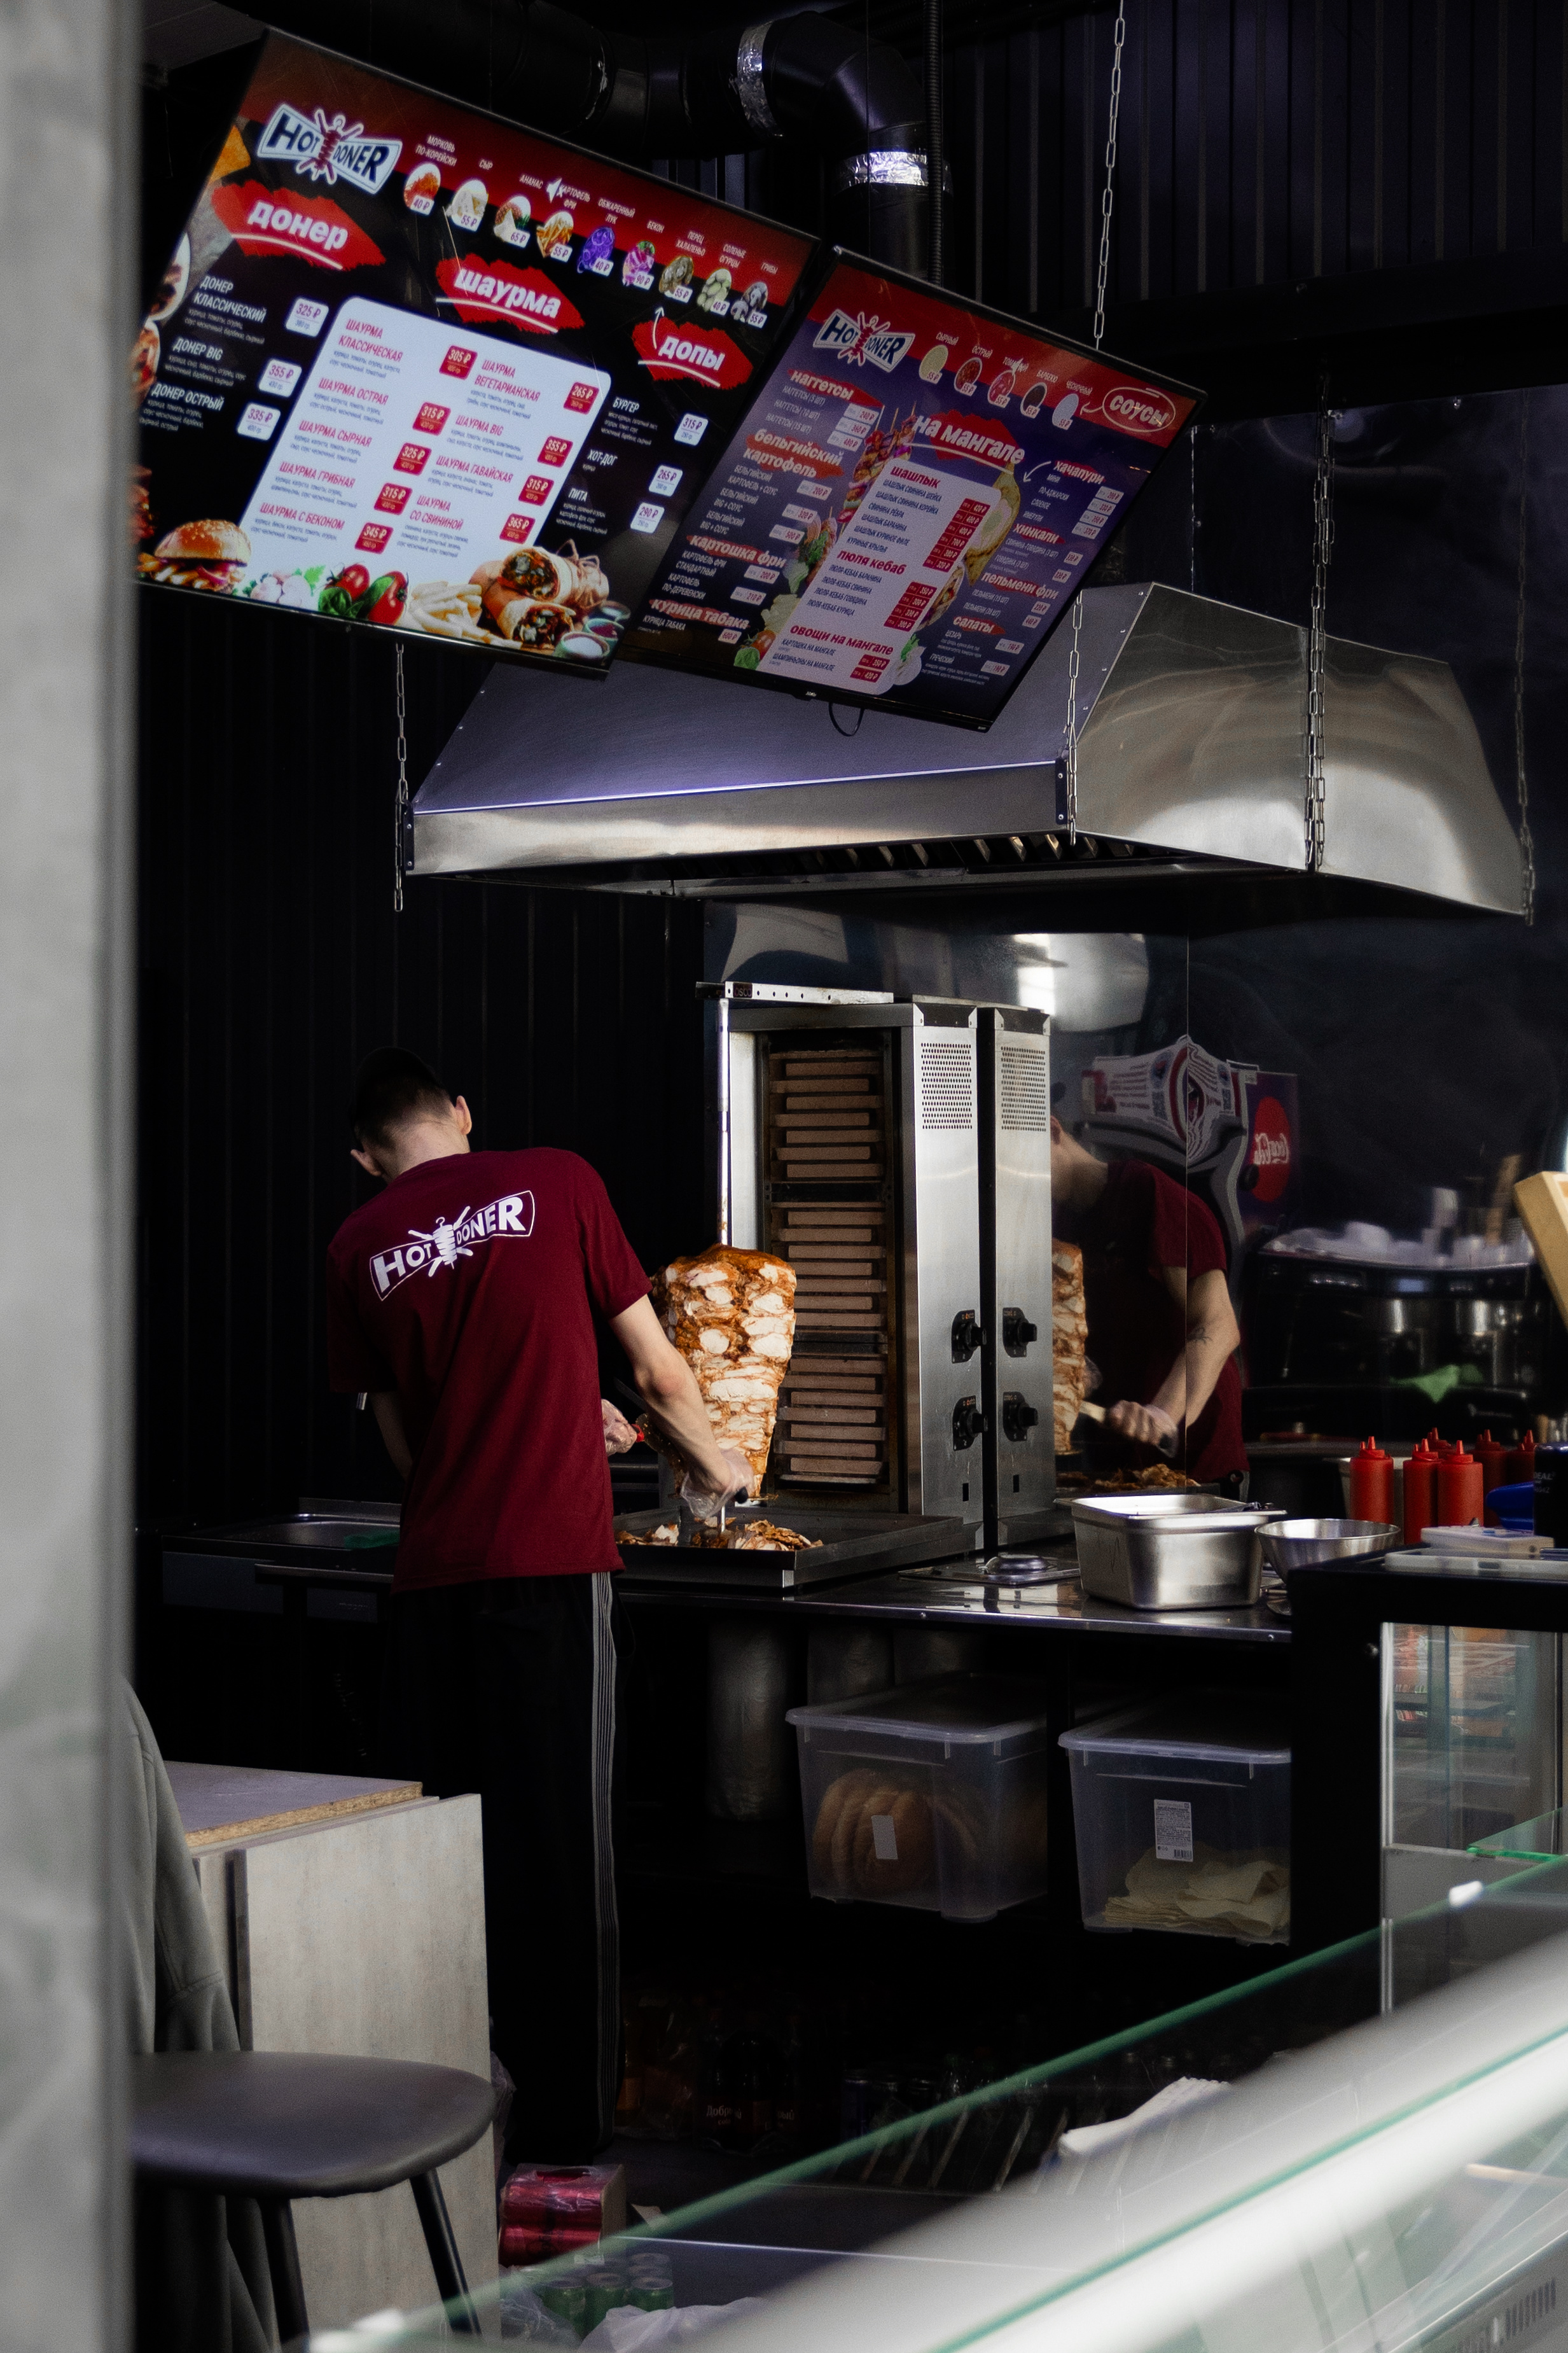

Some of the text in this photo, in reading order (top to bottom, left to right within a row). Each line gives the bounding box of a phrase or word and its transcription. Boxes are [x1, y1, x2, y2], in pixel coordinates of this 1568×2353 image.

[267, 113, 391, 183] HOT DONER
[414, 144, 458, 167] ПО-КОРЕЙСКИ
[426, 135, 457, 153] МОРКОВЬ
[478, 158, 494, 171] СЫР
[519, 174, 543, 189] АНАНАС
[562, 199, 577, 210] ФРИ
[597, 197, 636, 218] ОБЖАРЕННЫЙ
[246, 200, 351, 254] донер
[604, 213, 618, 225] ЛУК
[646, 220, 665, 233] БЕКОН
[675, 239, 706, 256] ХАЛАПЕНЬО
[686, 231, 705, 244] ПЕРЕЦ
[718, 255, 740, 269] ОГУРЦЫ
[722, 244, 746, 258] СОЛЕНЫЕ
[760, 262, 779, 274] ГРИБЫ
[199, 274, 235, 296] ДОНЕР
[452, 267, 564, 319] шаурма
[192, 289, 268, 323] КЛАССИЧЕСКИЙ
[345, 319, 385, 339] ШАУРМА
[822, 316, 905, 365] HOT DONER
[934, 330, 959, 346] СЫРНЫЙ
[172, 337, 225, 361] ДОНЕР BIG
[337, 334, 404, 362] КЛАССИЧЕСКАЯ
[657, 334, 727, 374] допы
[971, 344, 993, 359] ОСТРЫЙ
[481, 360, 517, 378] ШАУРМА
[150, 382, 186, 403] ДОНЕР
[183, 388, 226, 411] ОСТРЫЙ
[317, 377, 357, 396] ШАУРМА
[356, 388, 389, 405] ОСТРАЯ
[474, 374, 541, 401] ВЕГЕТАРИАНСКАЯ
[789, 370, 854, 400] наггетсы
[611, 396, 641, 414] БУРГЕР
[1106, 392, 1170, 429] СОУСЫ
[298, 420, 338, 438] ШАУРМА
[336, 429, 372, 447] СЫРНАЯ
[455, 414, 504, 436] ШАУРМА BIG
[753, 426, 845, 466] бельгийский
[912, 414, 1028, 466] на мангале
[435, 455, 471, 472] ШАУРМА
[469, 462, 515, 483] ГАВАЙСКАЯ
[585, 449, 618, 468] ХОТ-ДОГ
[741, 443, 821, 480] картофель
[279, 461, 319, 479] ШАУРМА
[317, 471, 356, 488] ГРИБНАЯ
[890, 466, 940, 488] шашлык
[1052, 461, 1104, 486] хачапури
[416, 495, 452, 512] ШАУРМА
[567, 487, 589, 501] ПИТА
[259, 502, 299, 520] ШАУРМА
[297, 511, 306, 521] С
[305, 513, 345, 530] БЕКОНОМ
[409, 510, 464, 531] СО СВИНИНОЙ
[1012, 522, 1059, 544] хинкали
[688, 534, 788, 569] картошка фри
[836, 549, 907, 575] люля кебаб
[980, 571, 1061, 601] пельмени фри
[648, 597, 751, 629] курица табака
[952, 616, 994, 634] салаты
[788, 624, 894, 655] овощи на мангале
[373, 1196, 525, 1293] HOT DONER
